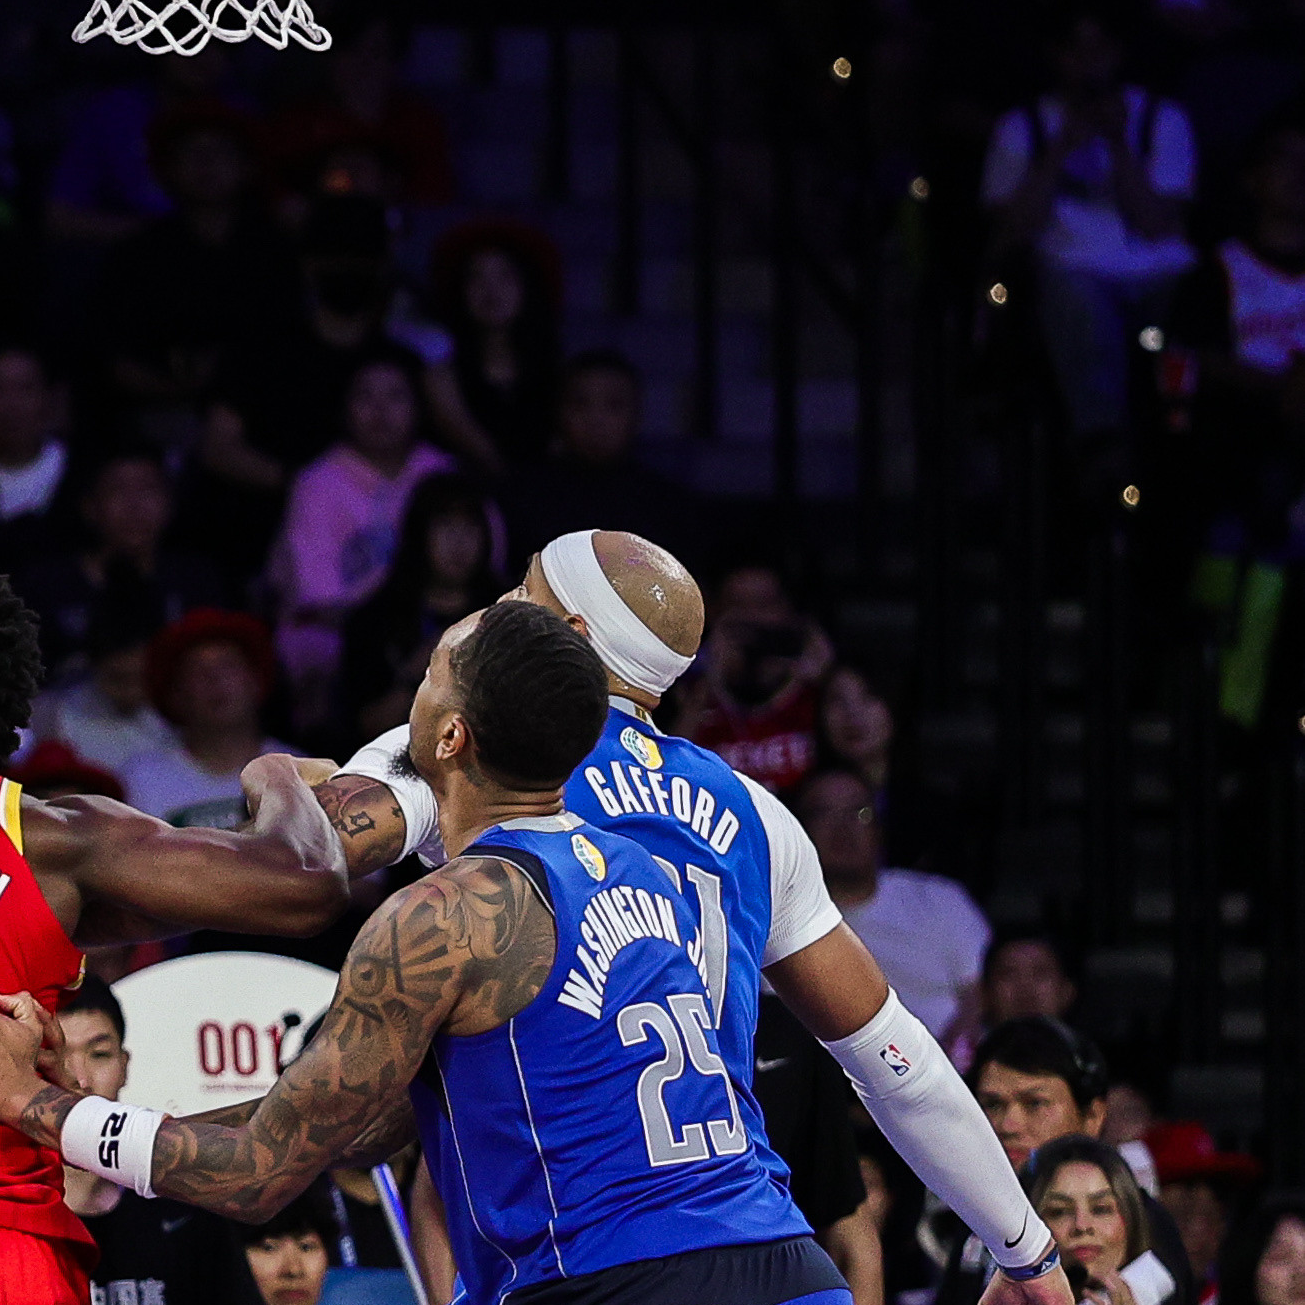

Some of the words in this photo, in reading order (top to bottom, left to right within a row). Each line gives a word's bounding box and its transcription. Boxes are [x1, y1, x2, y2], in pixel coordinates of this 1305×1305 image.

[584, 760, 741, 856] GAFFORD
[557, 884, 682, 1020] WASHINGTON
[616, 993, 748, 1168] 25
[98, 1111, 128, 1170] 25
